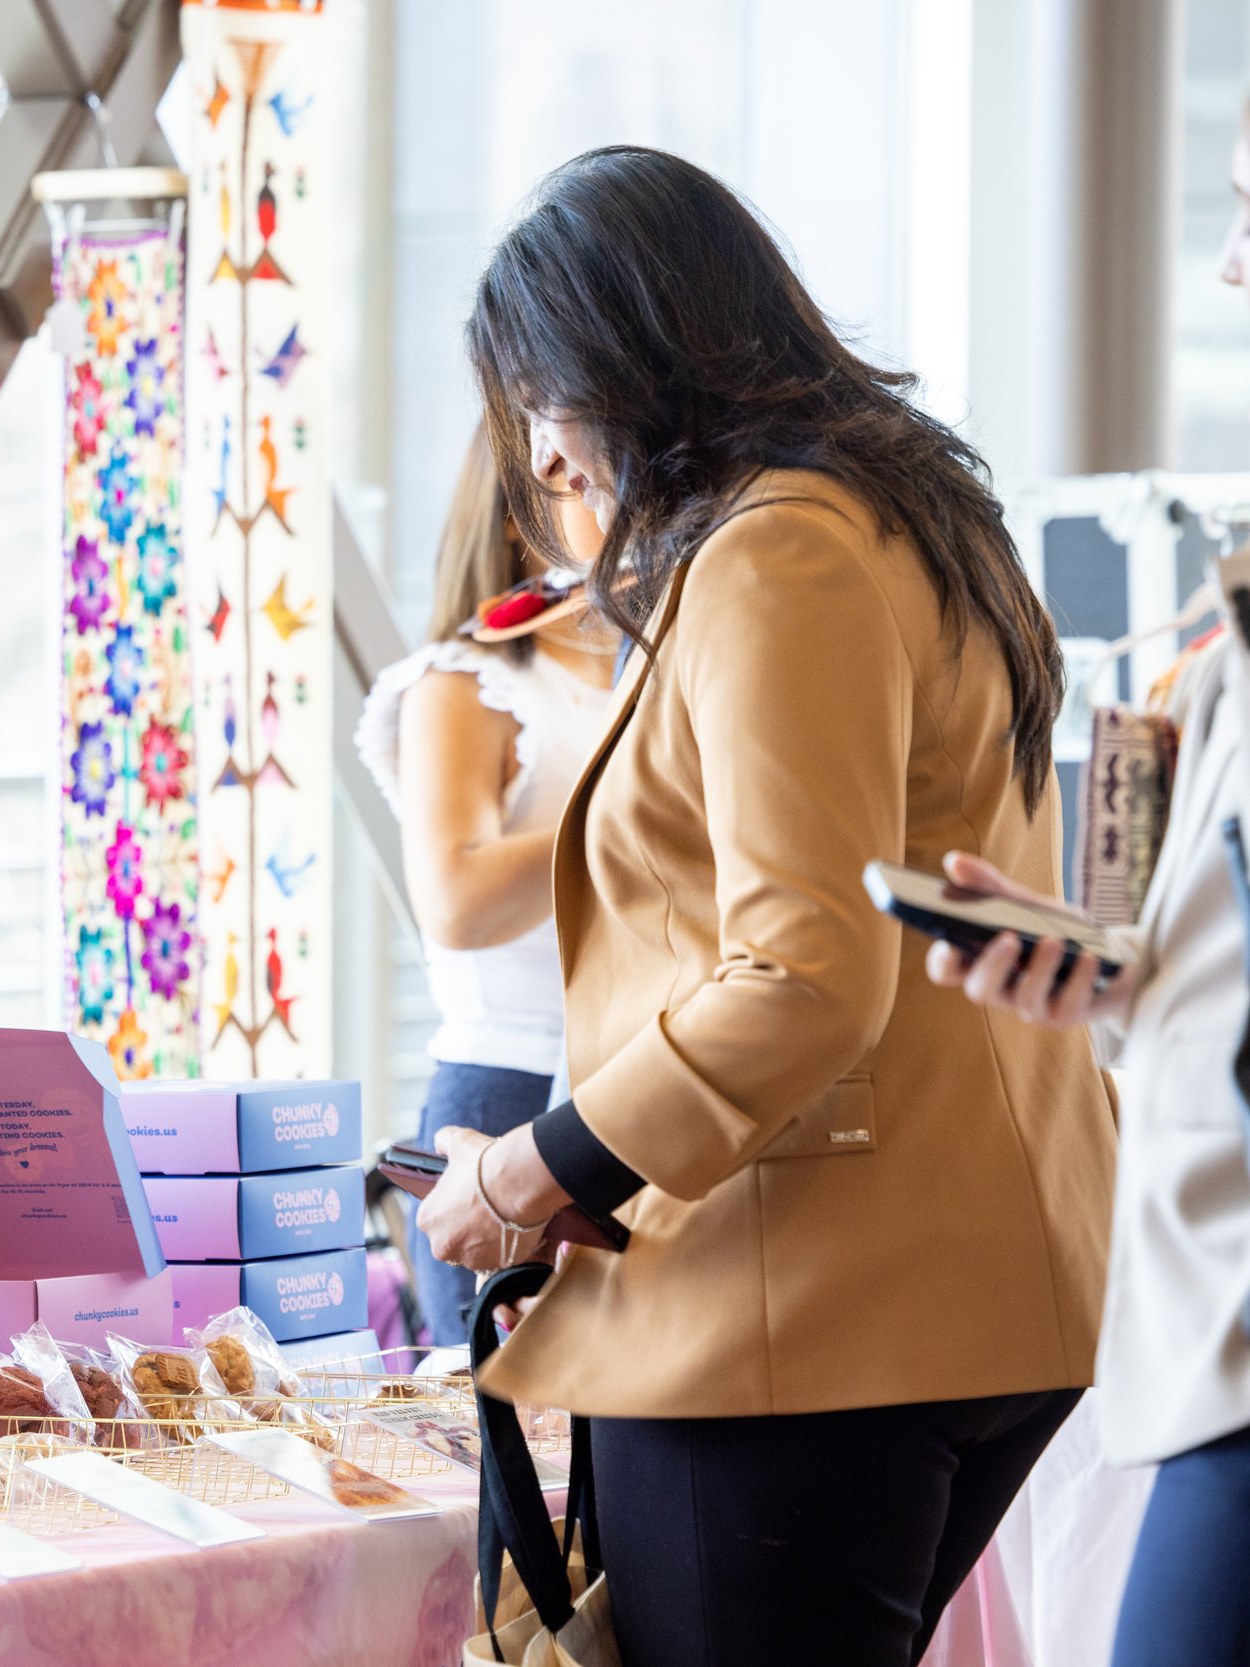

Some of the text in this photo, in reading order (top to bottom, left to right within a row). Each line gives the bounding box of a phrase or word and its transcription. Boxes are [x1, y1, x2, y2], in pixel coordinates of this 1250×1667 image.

[272, 1102, 322, 1124] CHUNKY
[275, 1122, 325, 1142] COOKIES
[273, 1188, 323, 1210] CHUNKY
[276, 1208, 326, 1228] COOKIES
[277, 1272, 326, 1295] CHUNKY
[280, 1292, 330, 1313] COOKIES
[74, 1307, 139, 1322] chunkycookies.us
